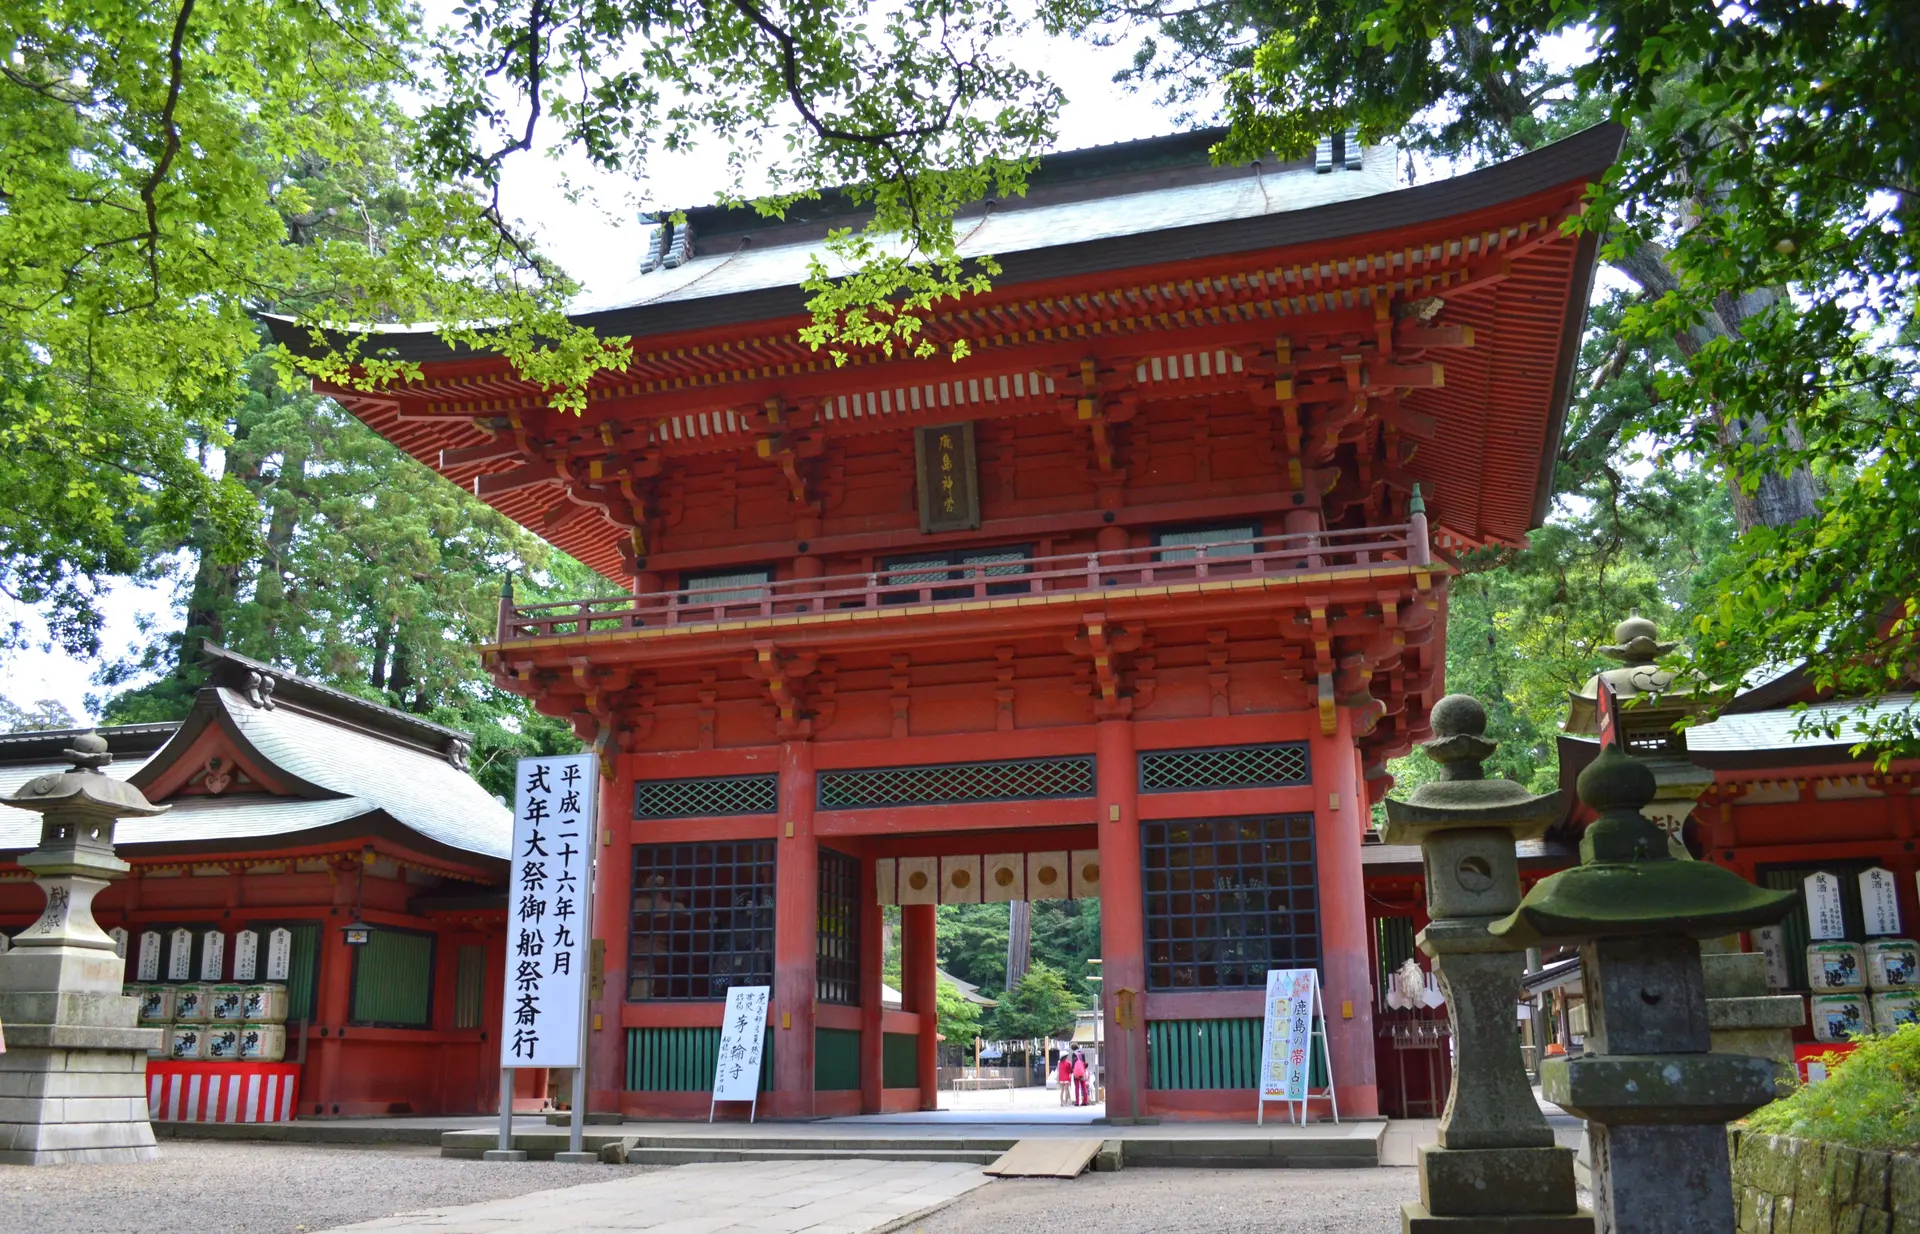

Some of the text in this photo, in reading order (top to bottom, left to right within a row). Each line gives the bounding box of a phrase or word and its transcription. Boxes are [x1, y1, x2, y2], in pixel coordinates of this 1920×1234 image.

[512, 765, 552, 1059] 式年大祭御船祭斎行
[552, 764, 582, 976] 平成二十六年九月
[1816, 875, 1827, 893] 献酒
[1871, 871, 1882, 889] 献酒
[1289, 1000, 1308, 1095] 鹿島の帯占い
